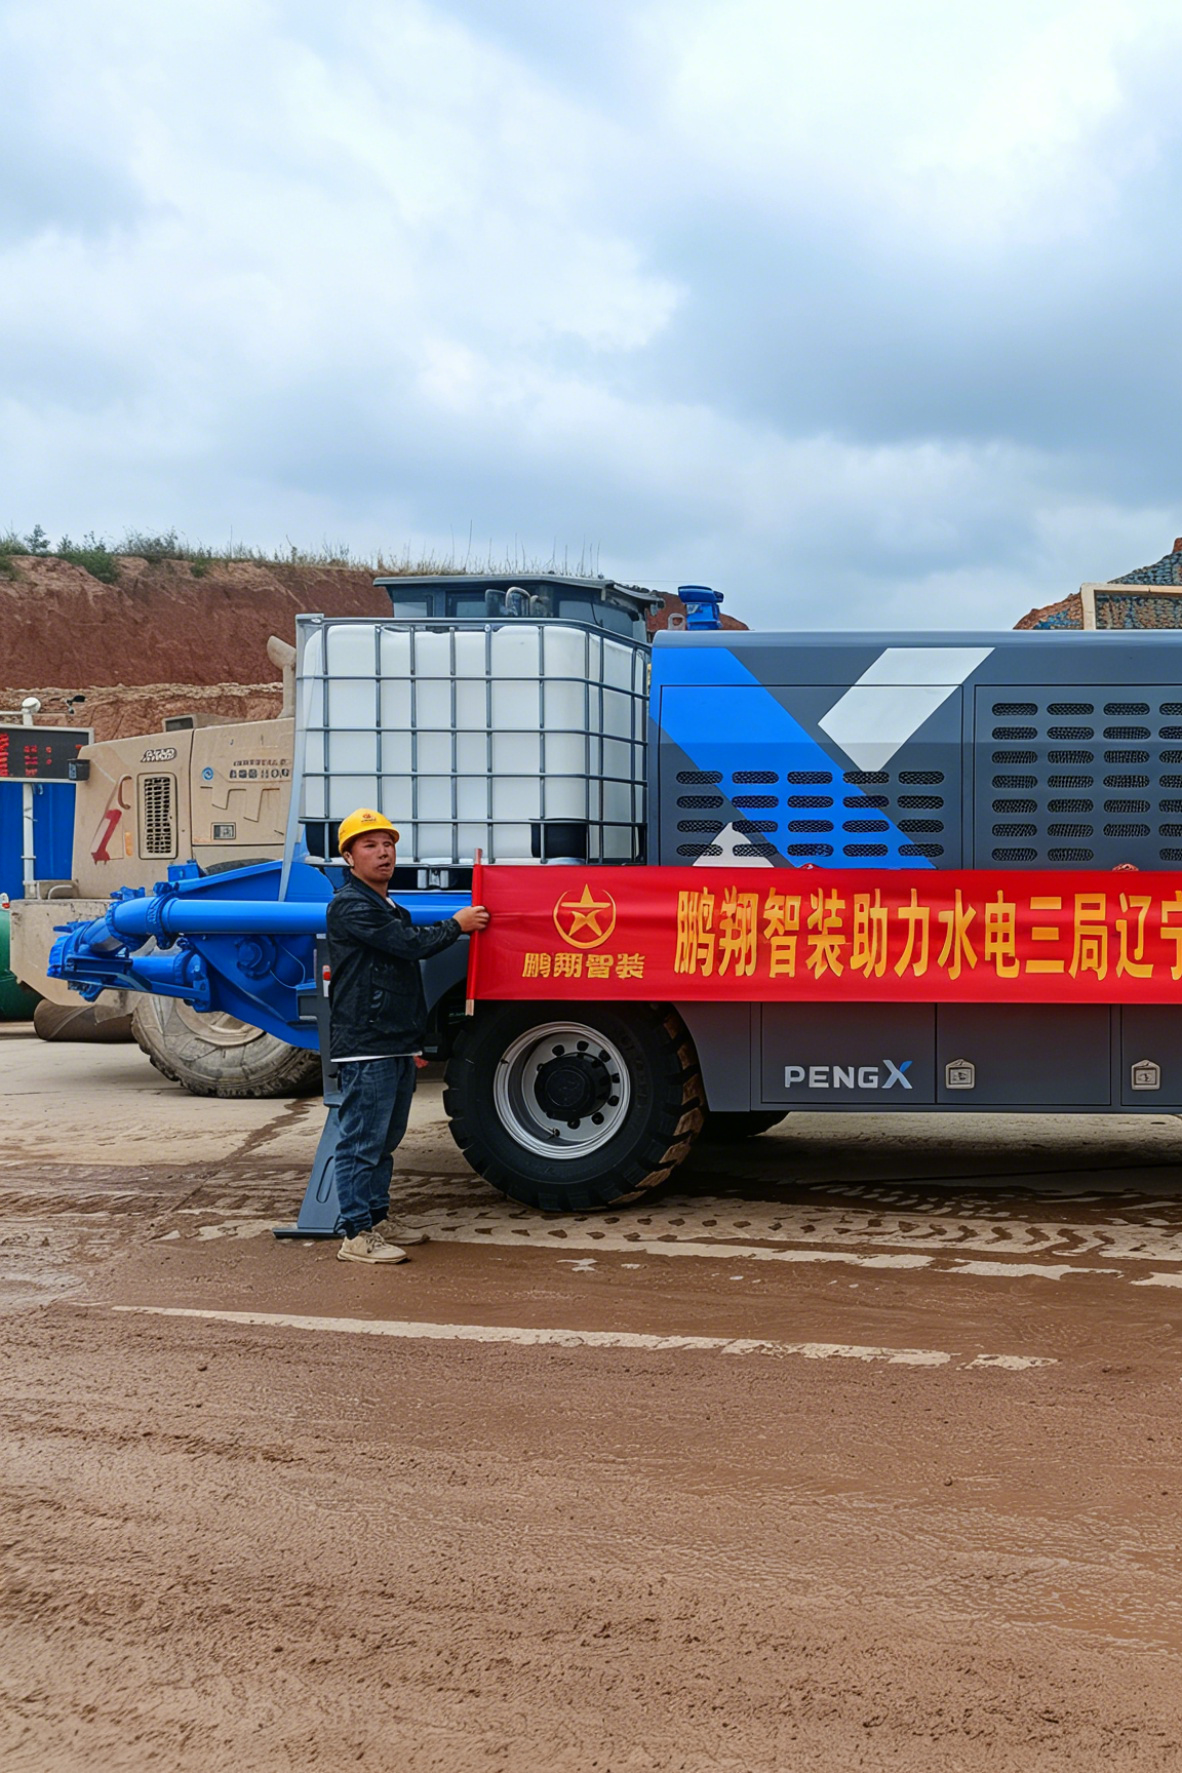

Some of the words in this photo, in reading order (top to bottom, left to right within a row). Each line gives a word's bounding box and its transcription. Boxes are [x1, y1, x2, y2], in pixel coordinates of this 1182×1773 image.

[521, 952, 646, 979] 鹏翔智装
[784, 1059, 913, 1089] PENGX
